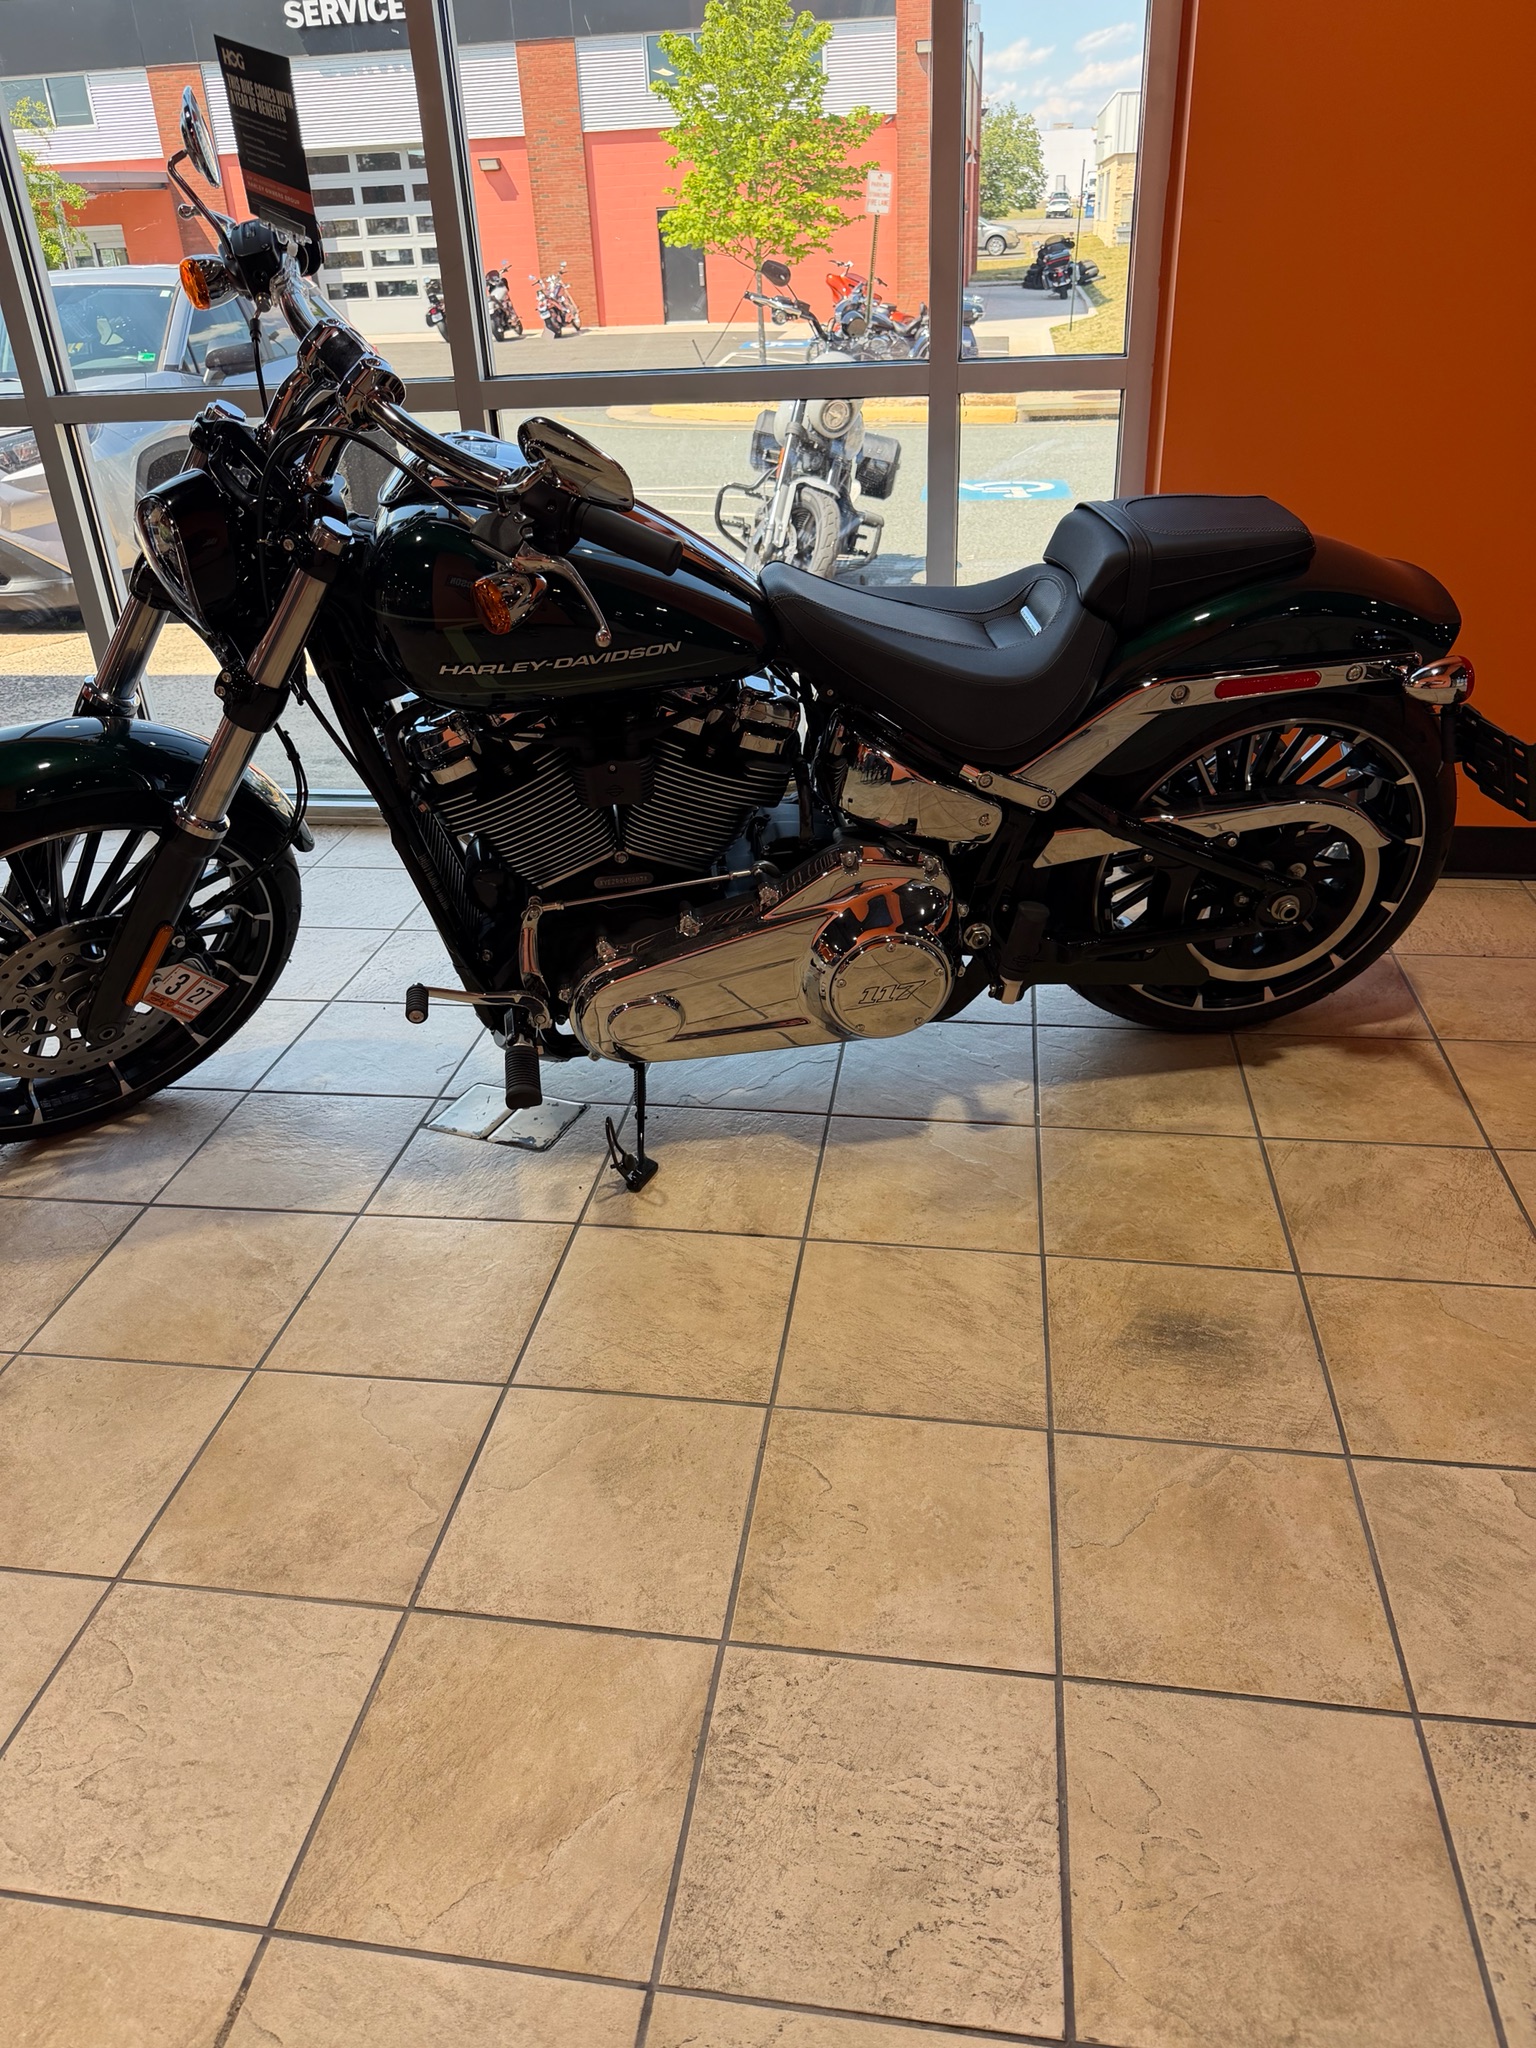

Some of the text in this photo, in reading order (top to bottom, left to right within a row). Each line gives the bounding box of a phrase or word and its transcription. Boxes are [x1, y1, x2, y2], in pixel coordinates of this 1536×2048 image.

[283, 0, 406, 29] SERVICE
[221, 47, 246, 71] HOG
[225, 72, 294, 109] THIS BIKE COMES WITH
[234, 91, 250, 110] YEAR
[248, 96, 258, 113] OF
[256, 98, 287, 123] BENEFITS
[439, 640, 682, 676] HARLEY-DAVIDSON
[164, 973, 191, 996] 3
[185, 987, 214, 1006] 27
[858, 980, 927, 1005] 117
